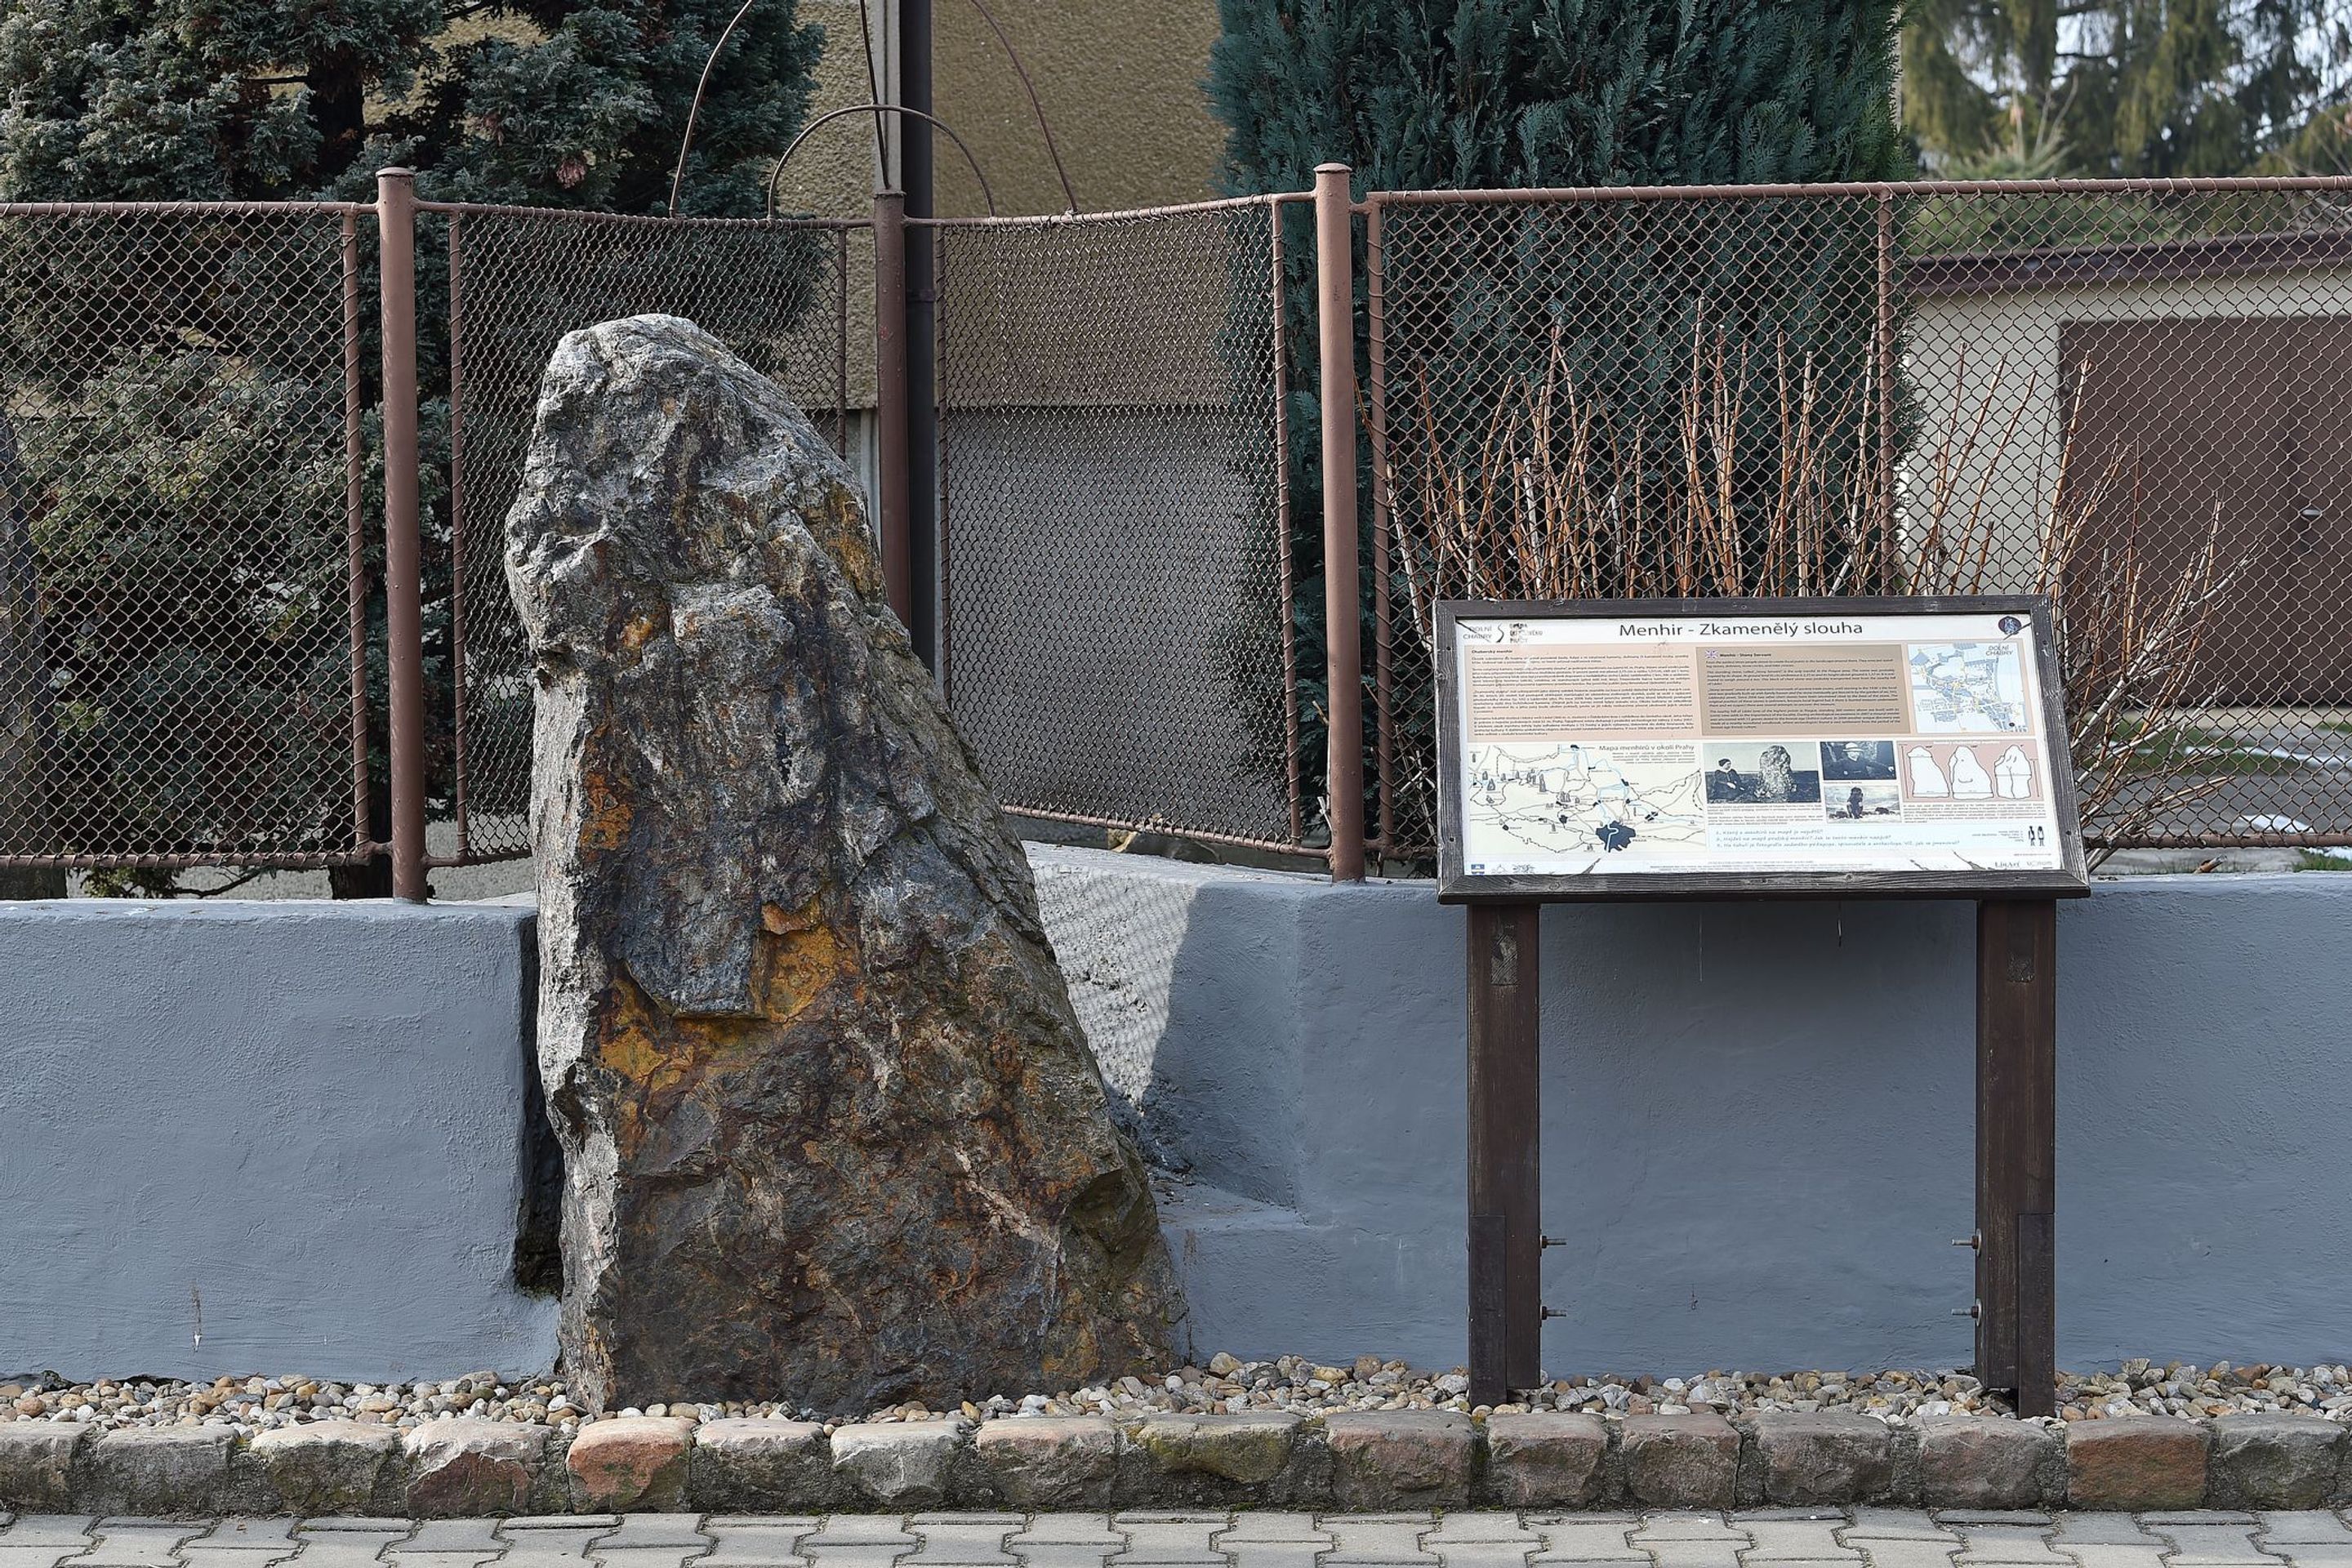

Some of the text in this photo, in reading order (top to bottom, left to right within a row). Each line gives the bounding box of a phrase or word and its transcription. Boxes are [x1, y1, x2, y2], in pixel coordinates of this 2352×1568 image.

[1619, 624, 1682, 635] Menhir
[1699, 622, 1798, 637] Zkamenělý
[1804, 621, 1863, 634] slouha
